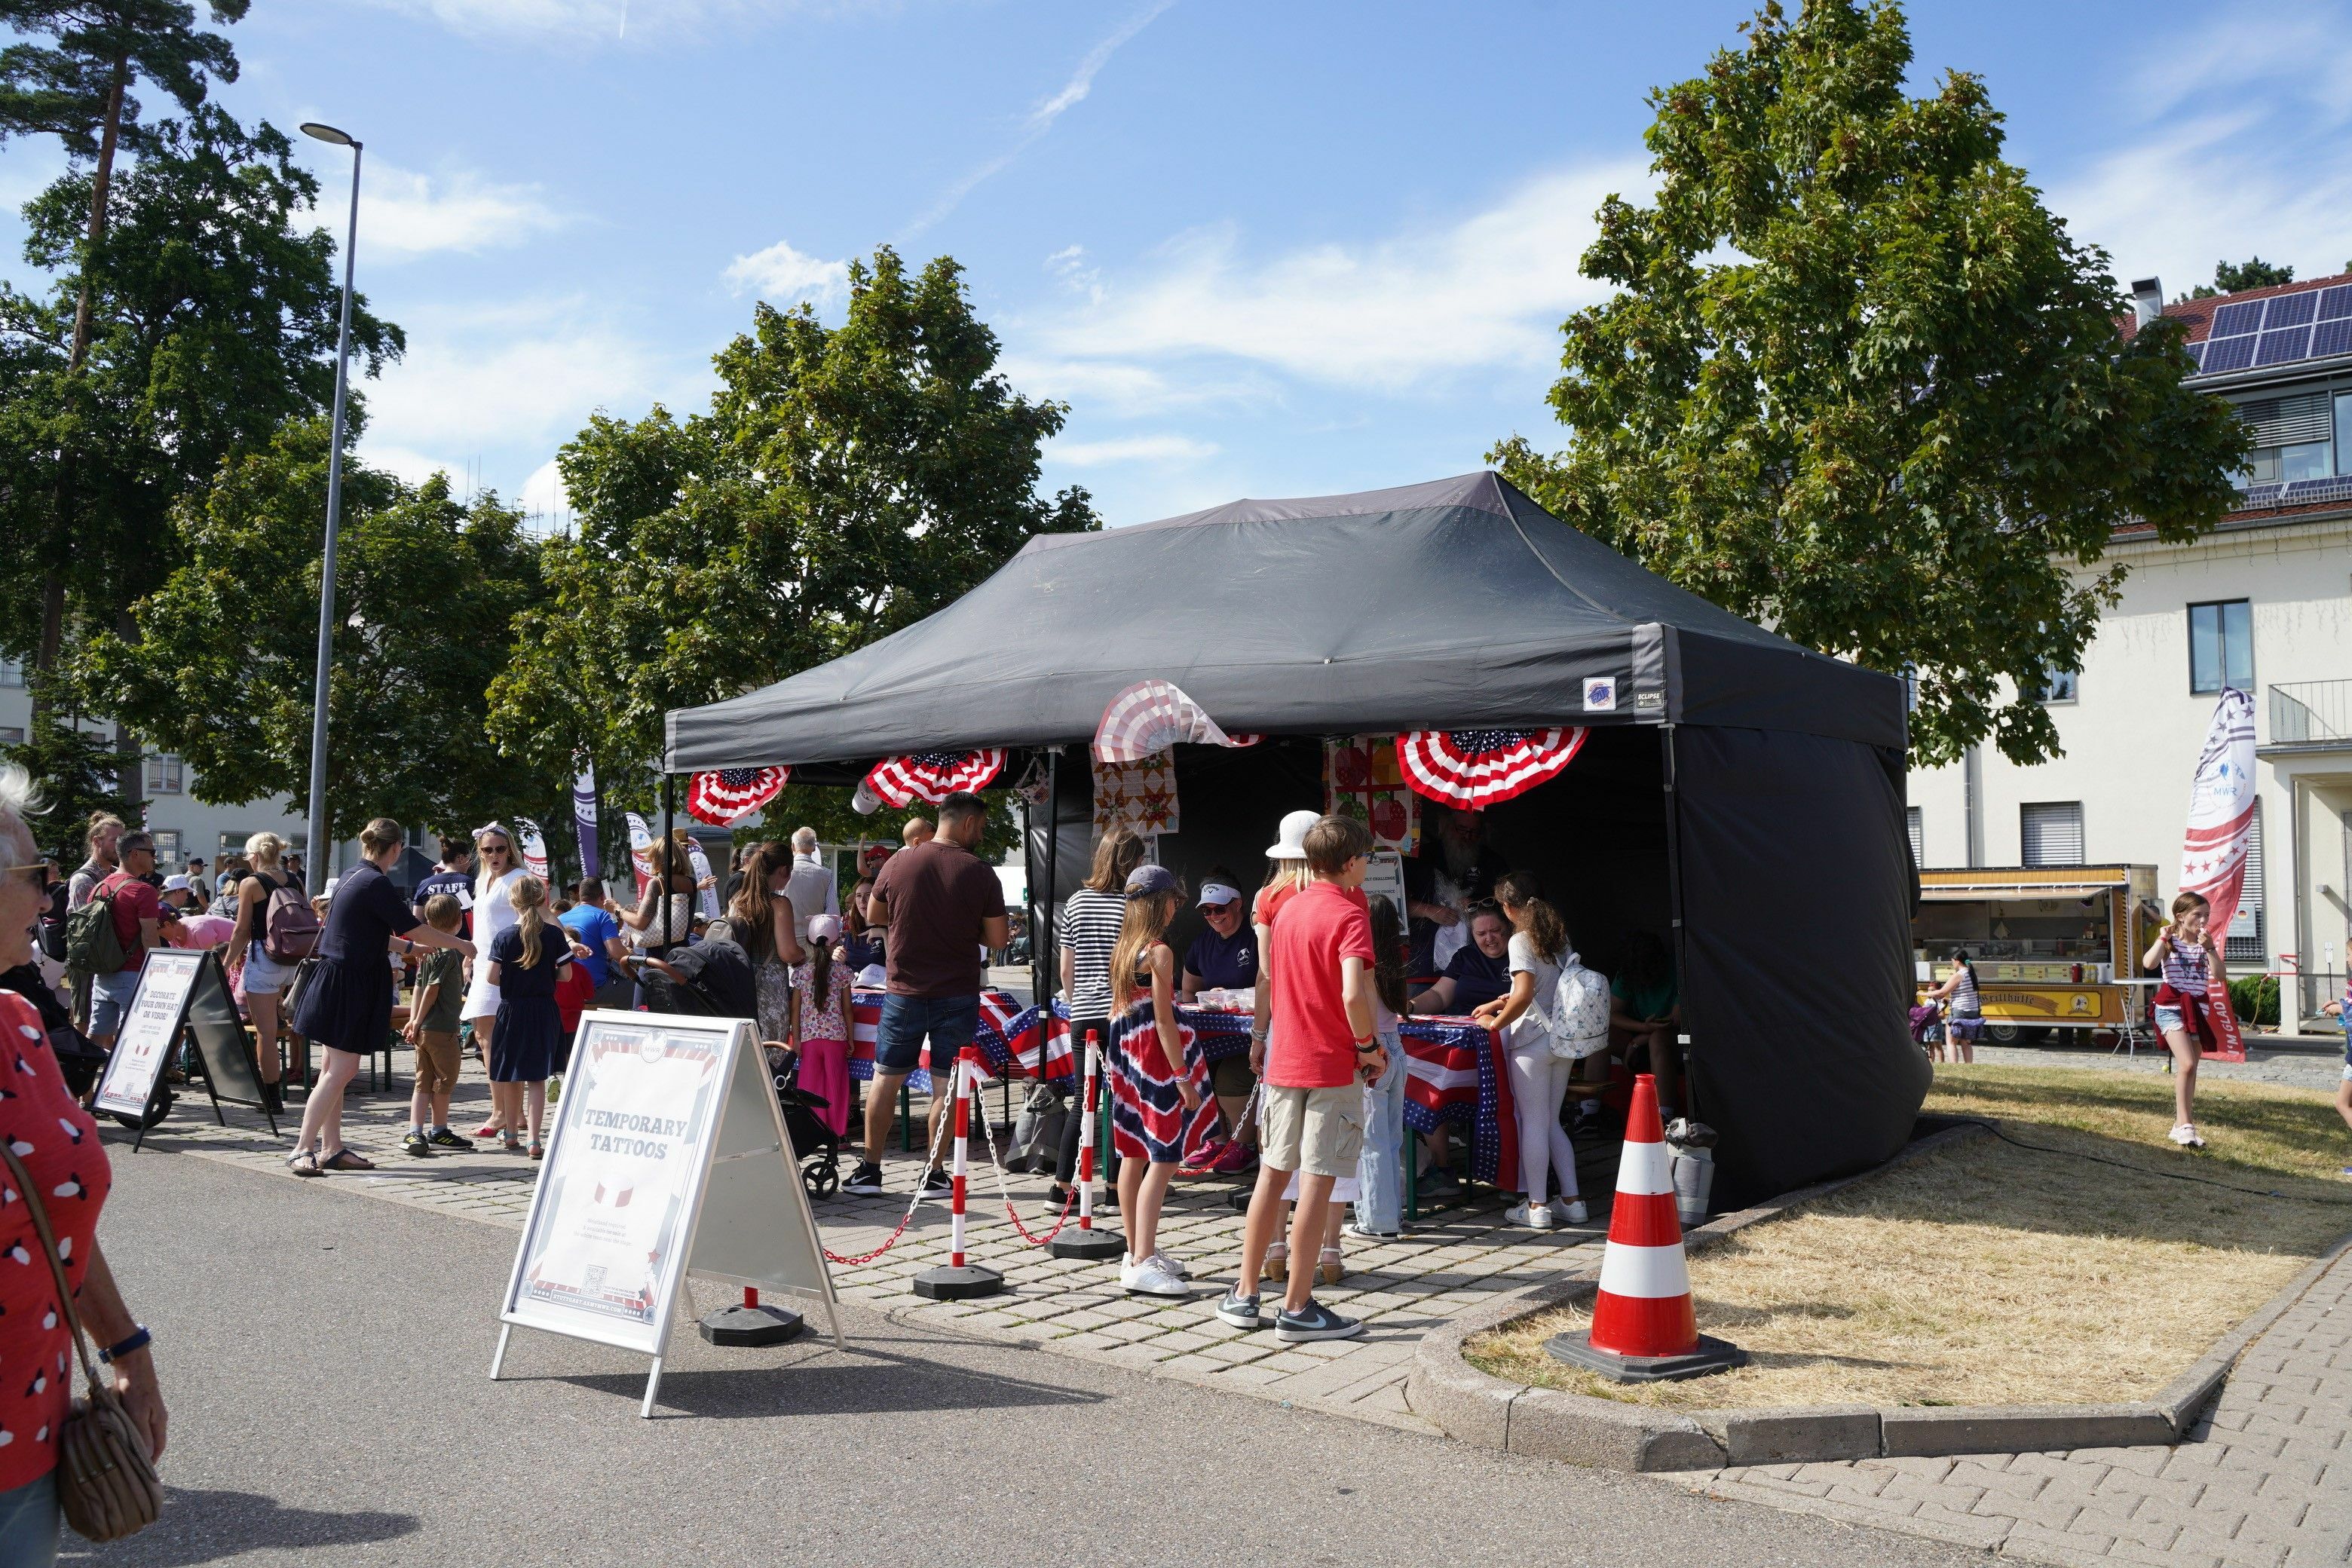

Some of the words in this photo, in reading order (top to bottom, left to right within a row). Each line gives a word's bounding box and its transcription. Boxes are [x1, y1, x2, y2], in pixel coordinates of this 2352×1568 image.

[2213, 787, 2237, 796] MWR
[427, 883, 467, 895] STAFF
[150, 991, 176, 1000] DECORATE
[2213, 1001, 2234, 1033] GLAD
[585, 1108, 688, 1138] TEMPORARY
[590, 1133, 668, 1160] TATTOOS
